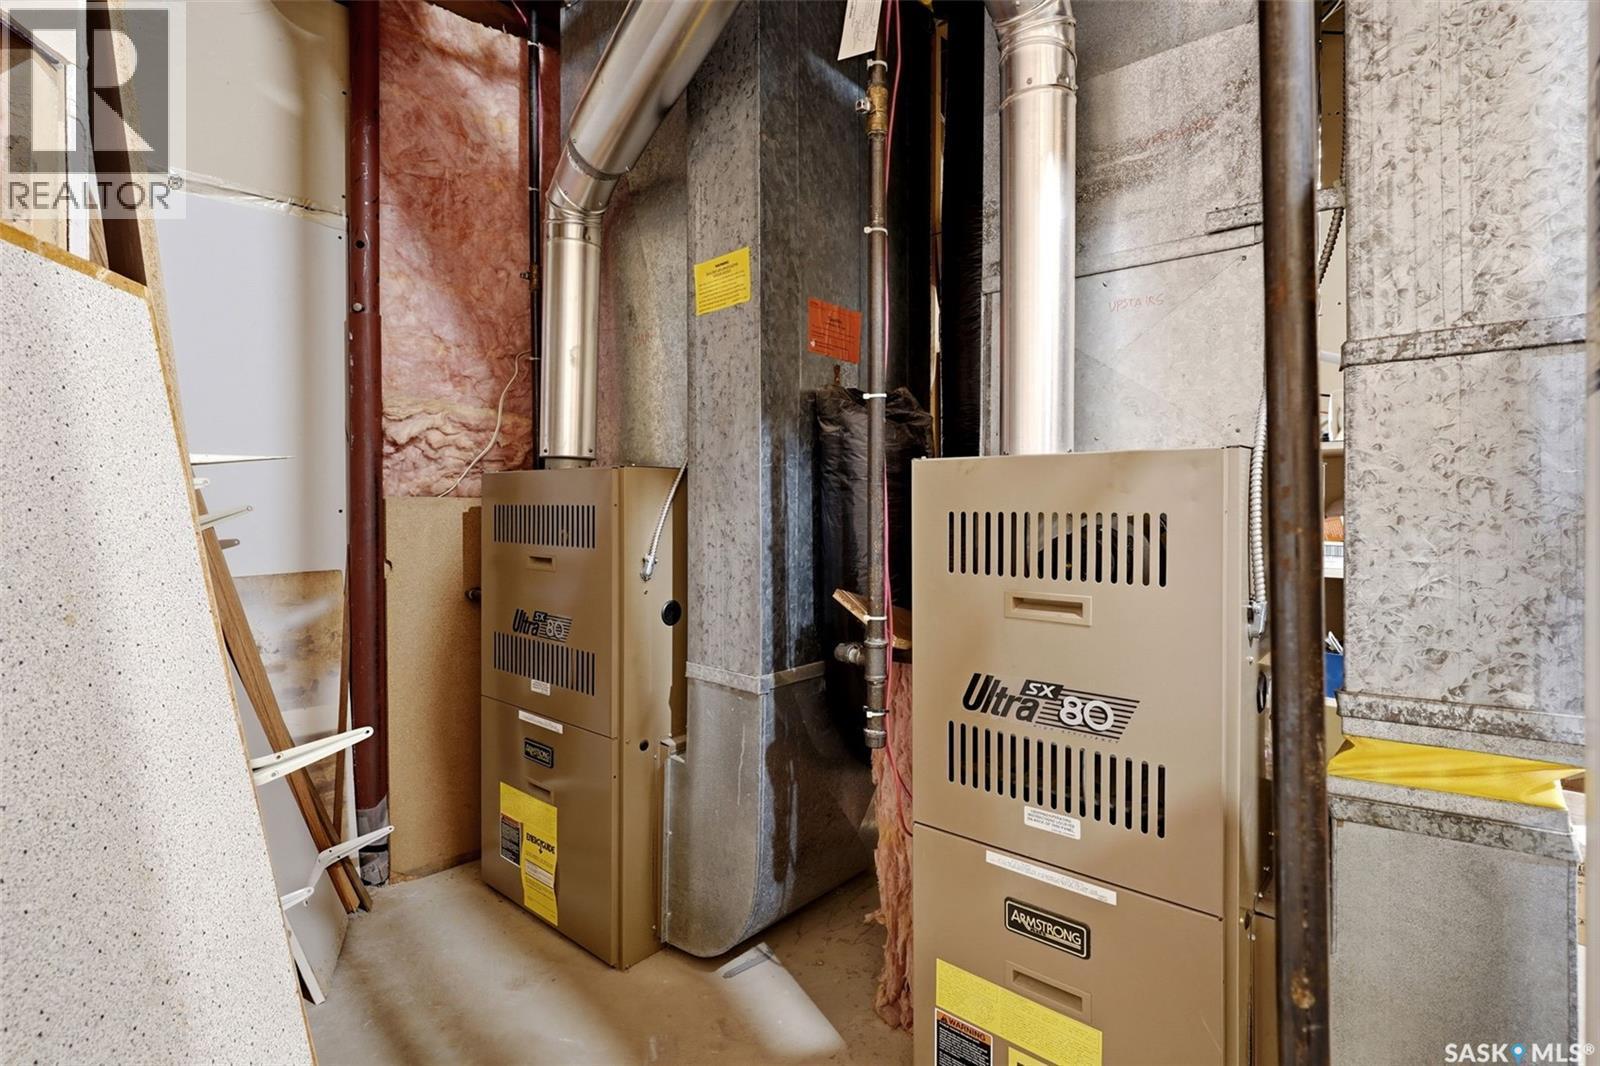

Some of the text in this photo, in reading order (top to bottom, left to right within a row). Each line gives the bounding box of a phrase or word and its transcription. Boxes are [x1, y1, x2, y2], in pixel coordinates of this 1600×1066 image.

[1108, 293, 1164, 313] UPSTAIRS
[512, 608, 540, 636] Ultra
[546, 620, 564, 638] 80
[962, 672, 1115, 733] Ultra SX 80
[1011, 909, 1082, 946] ARMSTRONG
[949, 1018, 986, 1041] WARNING
